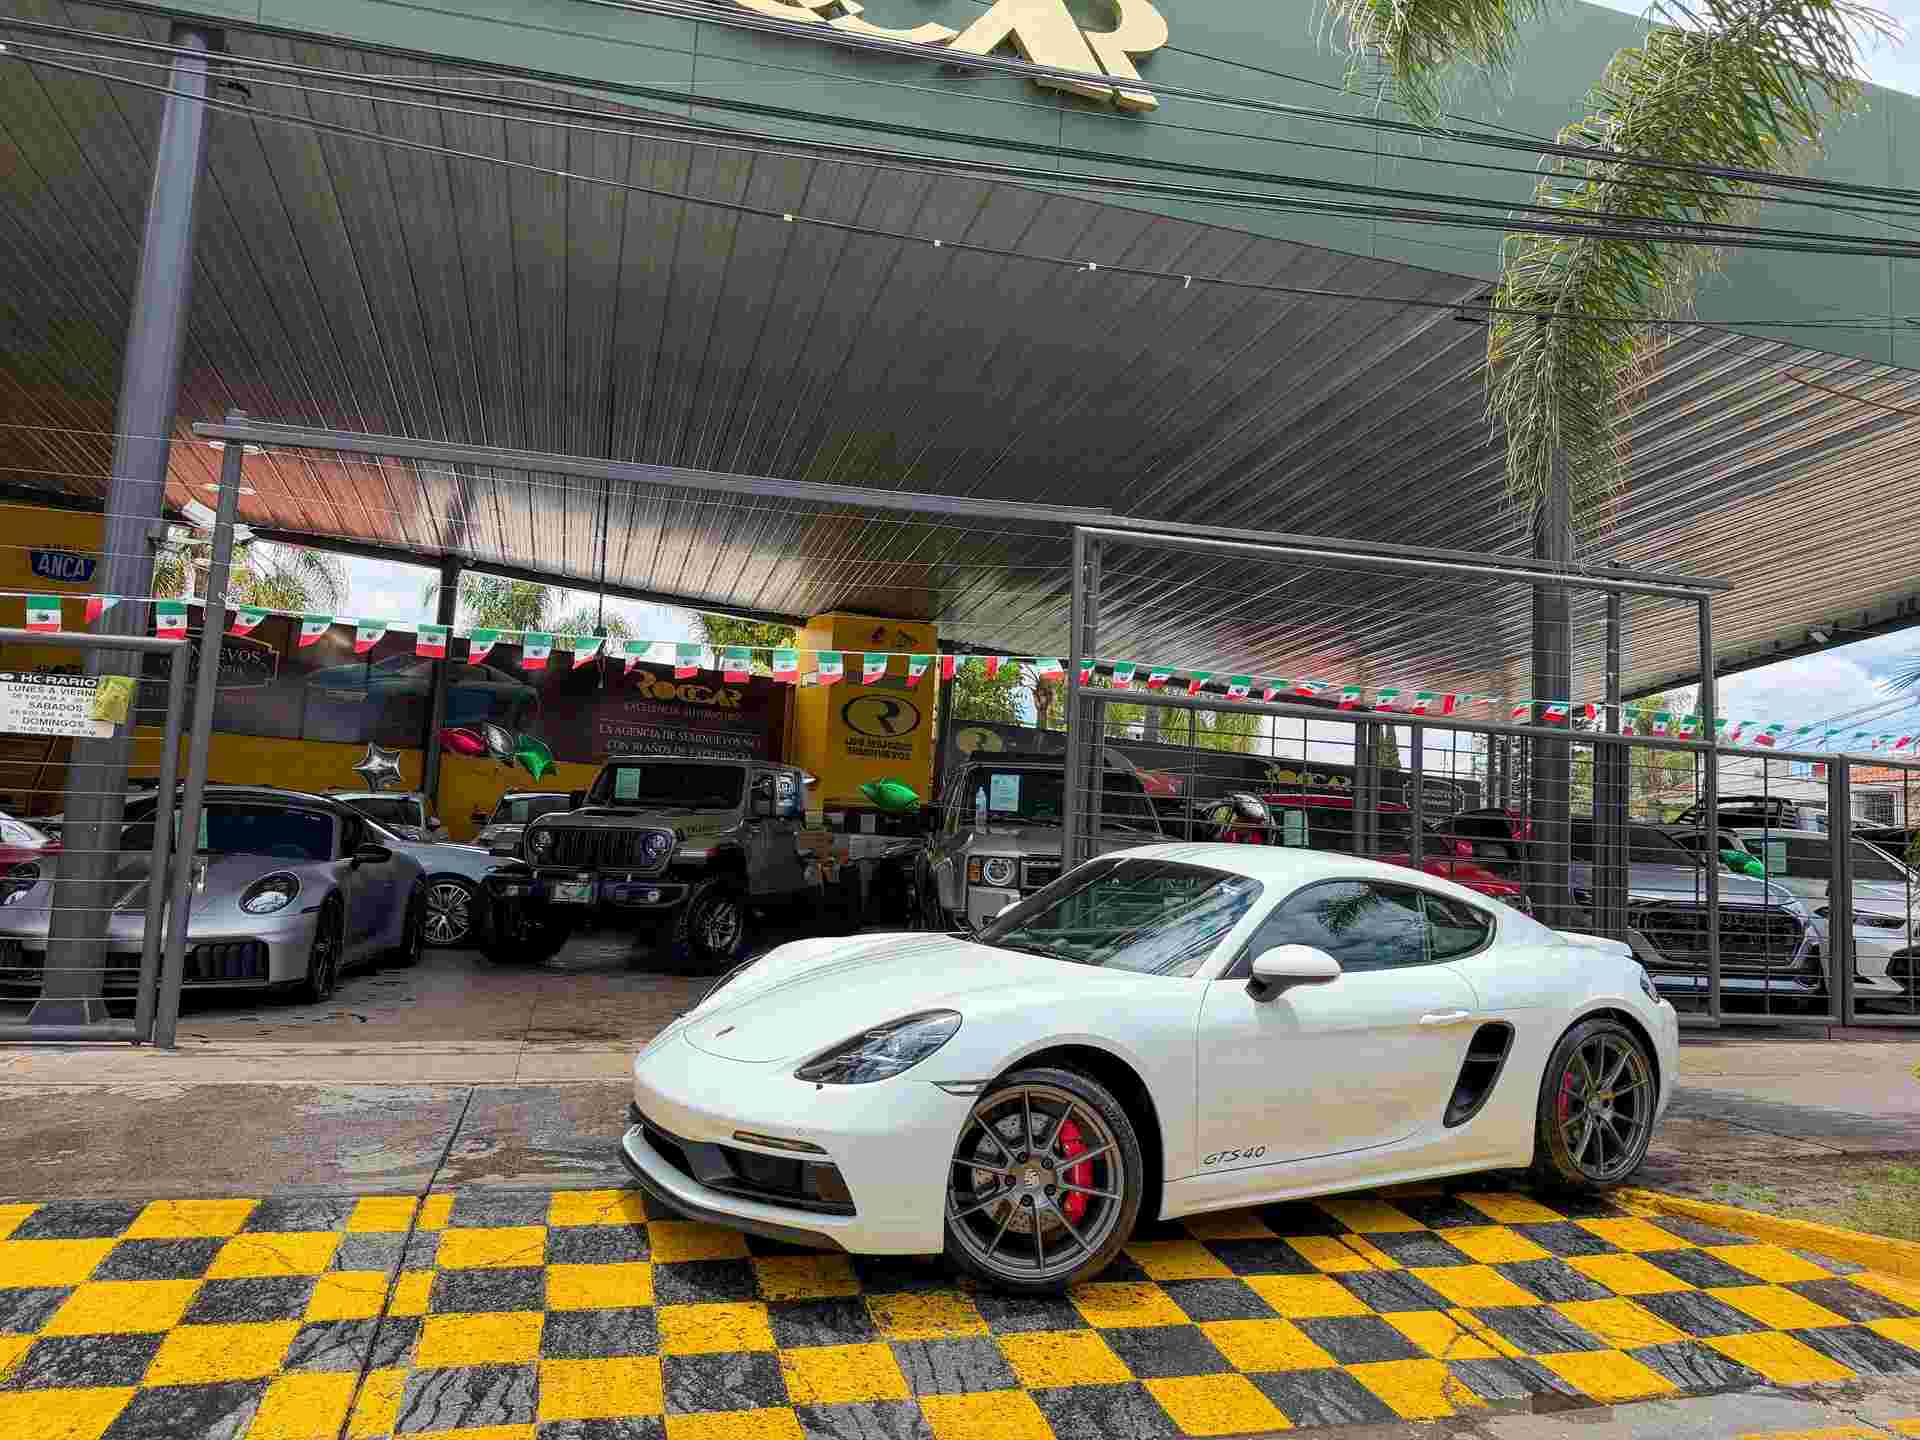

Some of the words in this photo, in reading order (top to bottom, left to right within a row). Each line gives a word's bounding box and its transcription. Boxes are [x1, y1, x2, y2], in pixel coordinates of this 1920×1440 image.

[20, 673, 97, 687] HORARIO
[7, 684, 46, 695] LUNES
[22, 715, 85, 728] DOMINGOS
[1202, 1149, 1241, 1165] GTS
